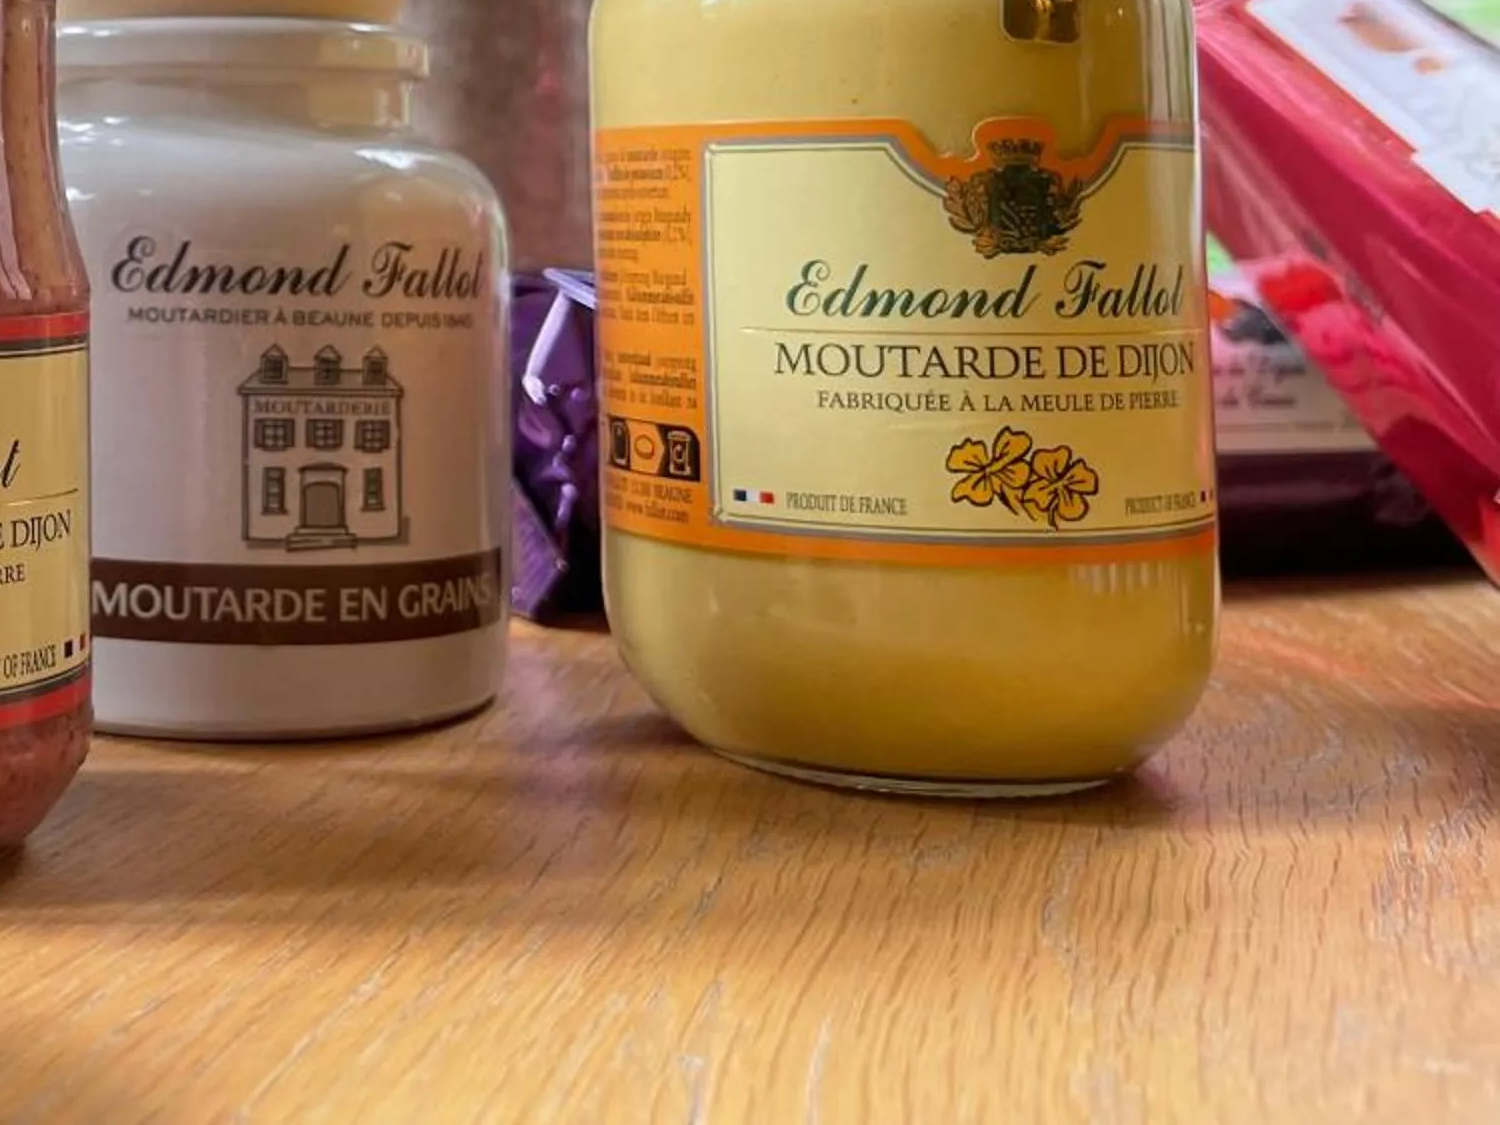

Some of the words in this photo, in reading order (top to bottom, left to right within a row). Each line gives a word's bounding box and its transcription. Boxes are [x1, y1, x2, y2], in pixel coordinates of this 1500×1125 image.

[111, 236, 350, 299] Edmond
[362, 241, 483, 302] Fallot
[785, 258, 1039, 319] Edmond
[1054, 260, 1184, 319] Fallot
[128, 306, 269, 327] MOUTARDIER
[293, 309, 374, 327] BEAUNE
[381, 311, 441, 329] DEPUIS
[774, 341, 1047, 380] MOUTARDE
[1057, 343, 1110, 378] DE
[1118, 340, 1196, 384] DIJON
[254, 399, 391, 417] MOUTARDERIE
[817, 387, 951, 414] FABRIQUÉE
[959, 387, 977, 412] À
[983, 394, 1014, 413] LA
[1021, 393, 1095, 412] MEULE
[1100, 393, 1125, 410] DE
[1130, 389, 1179, 409] PIERRE
[785, 491, 837, 512] PRODUIT
[840, 494, 858, 514] DE
[859, 496, 908, 516] FRANCE
[10, 510, 72, 556] DIJON
[92, 579, 327, 623] MOUTARDE
[340, 587, 387, 621] EN
[399, 572, 491, 618] GRAINS
[4, 652, 19, 678] OF
